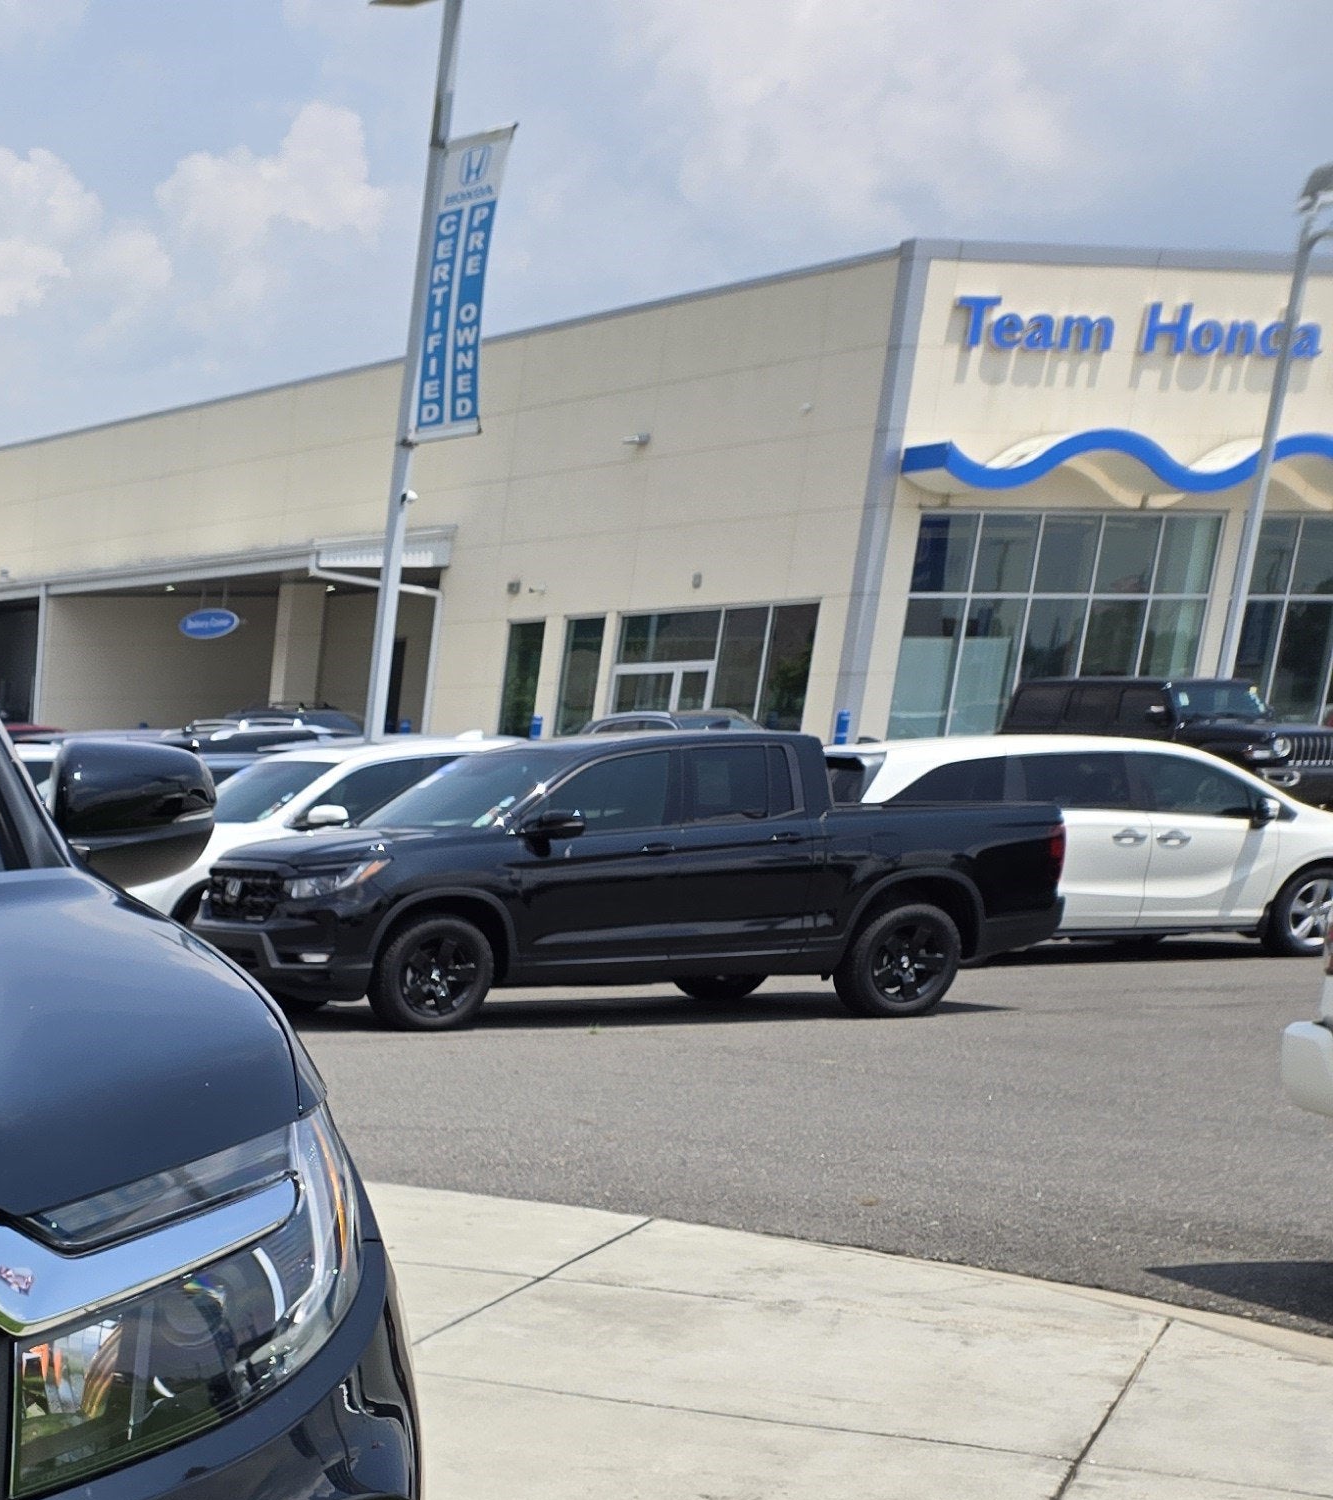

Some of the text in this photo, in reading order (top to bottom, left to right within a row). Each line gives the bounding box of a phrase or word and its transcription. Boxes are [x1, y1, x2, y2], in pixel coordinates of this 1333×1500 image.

[420, 214, 458, 423] CERTIFIED
[452, 206, 489, 417] PRE OWNED
[956, 296, 1116, 353] Team
